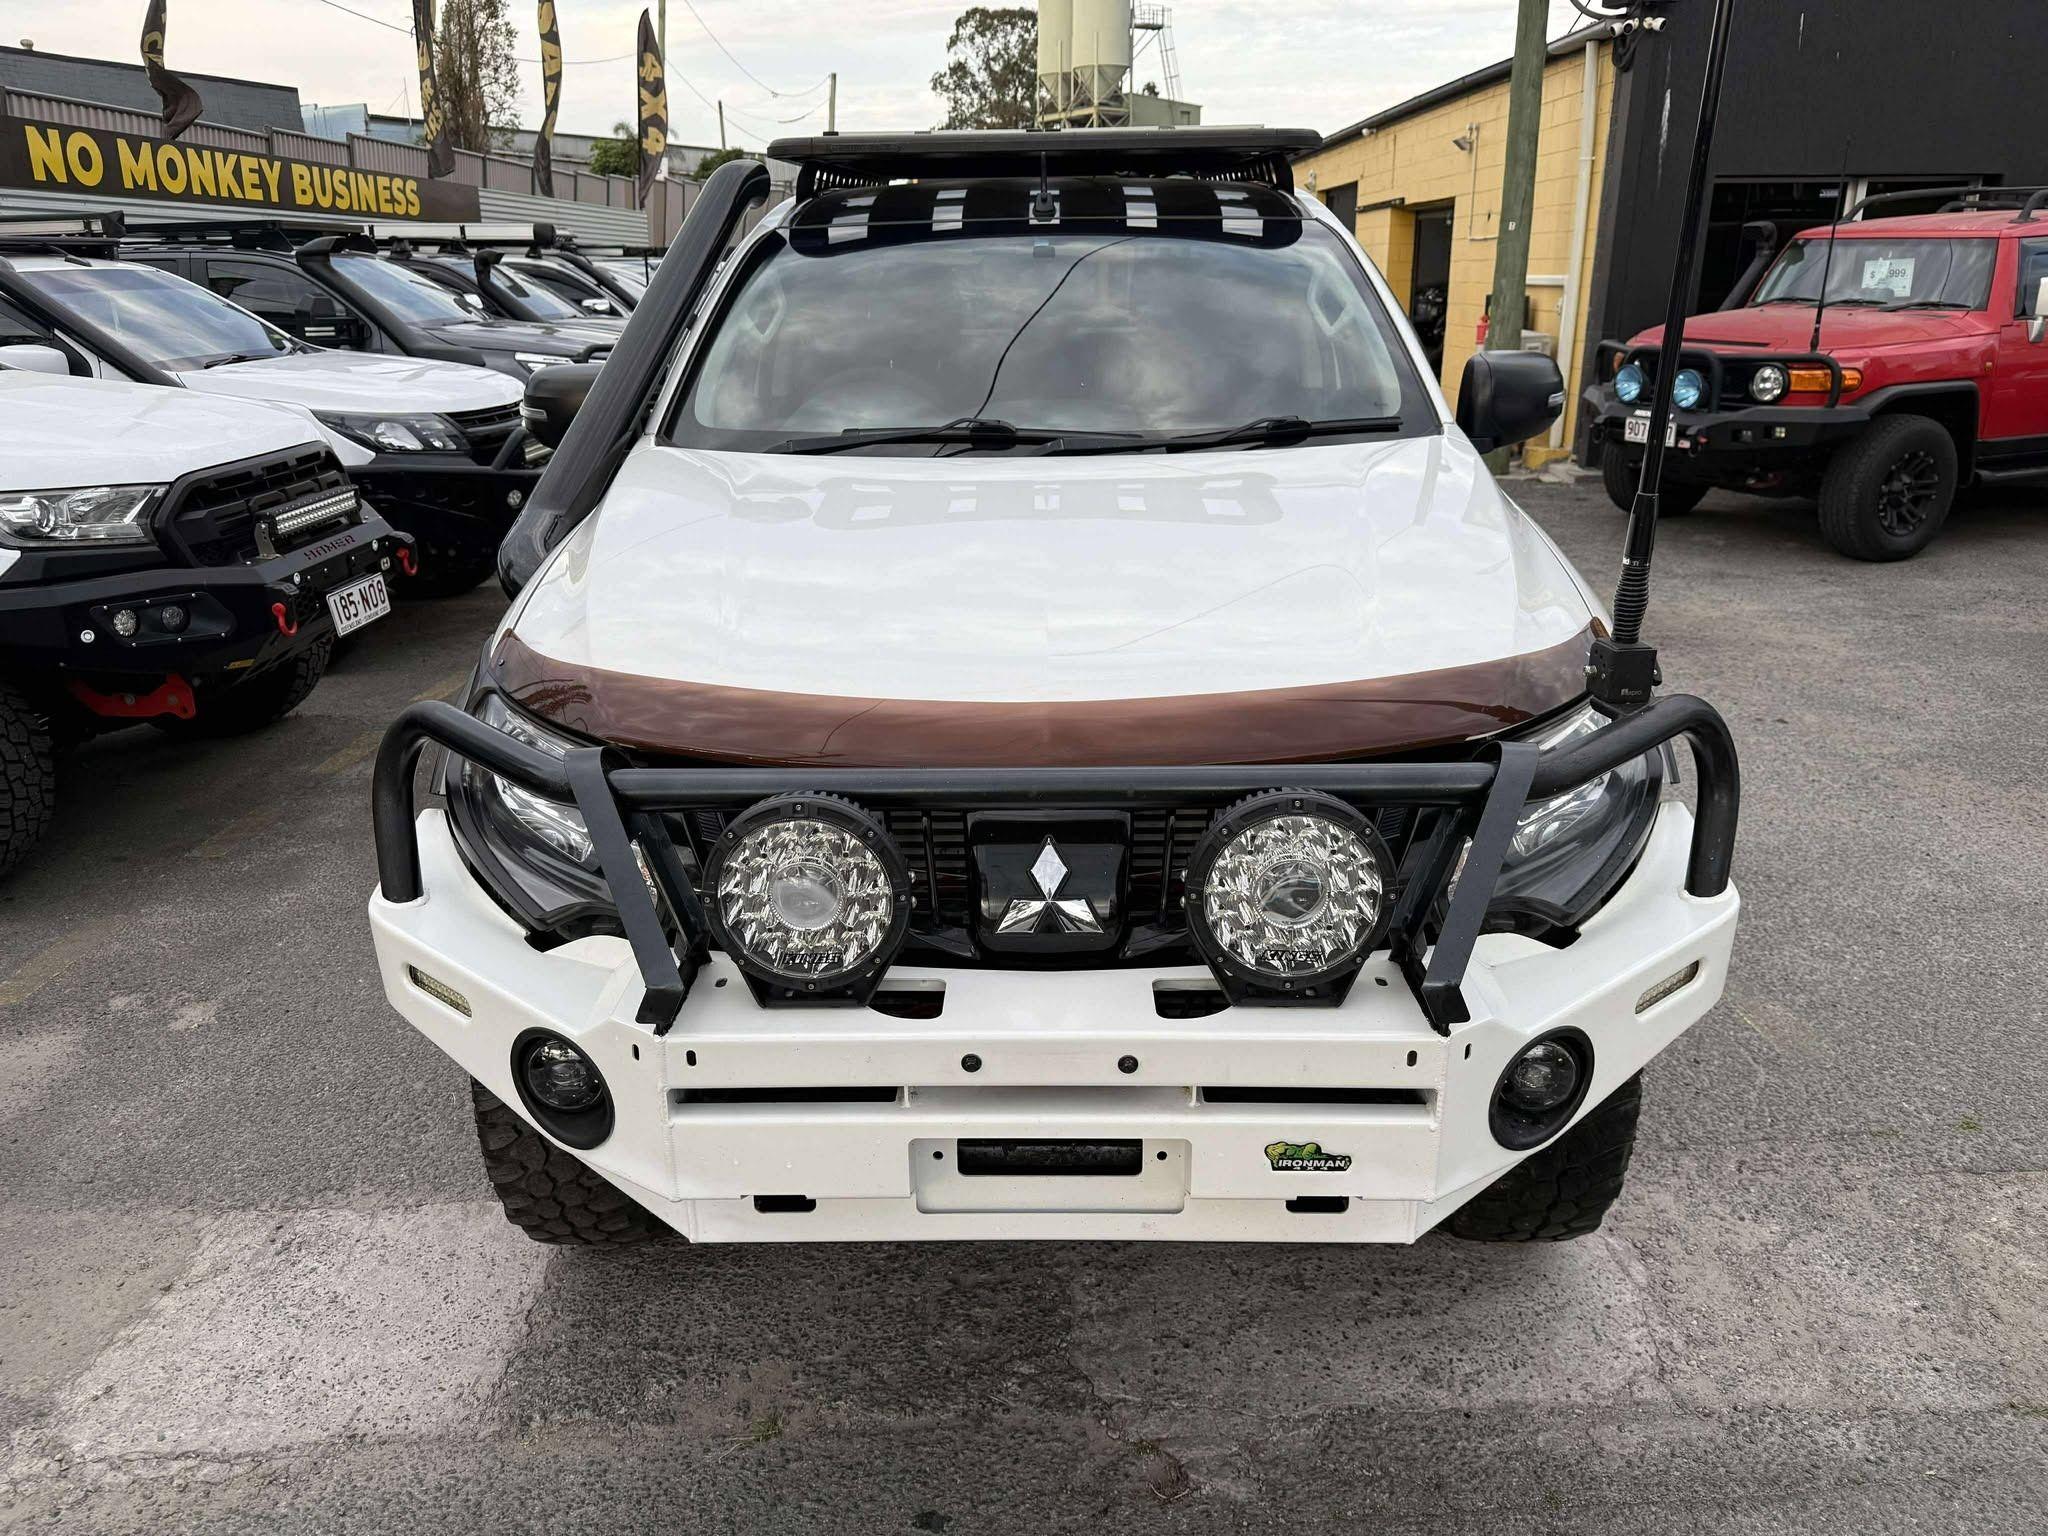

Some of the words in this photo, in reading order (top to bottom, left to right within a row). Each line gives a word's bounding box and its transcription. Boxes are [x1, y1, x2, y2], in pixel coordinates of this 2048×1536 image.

[24, 125, 104, 187] NO
[116, 137, 281, 202] MONKEY
[291, 163, 421, 216] BUSINESS
[1278, 1159, 1345, 1168] IRONMAN
